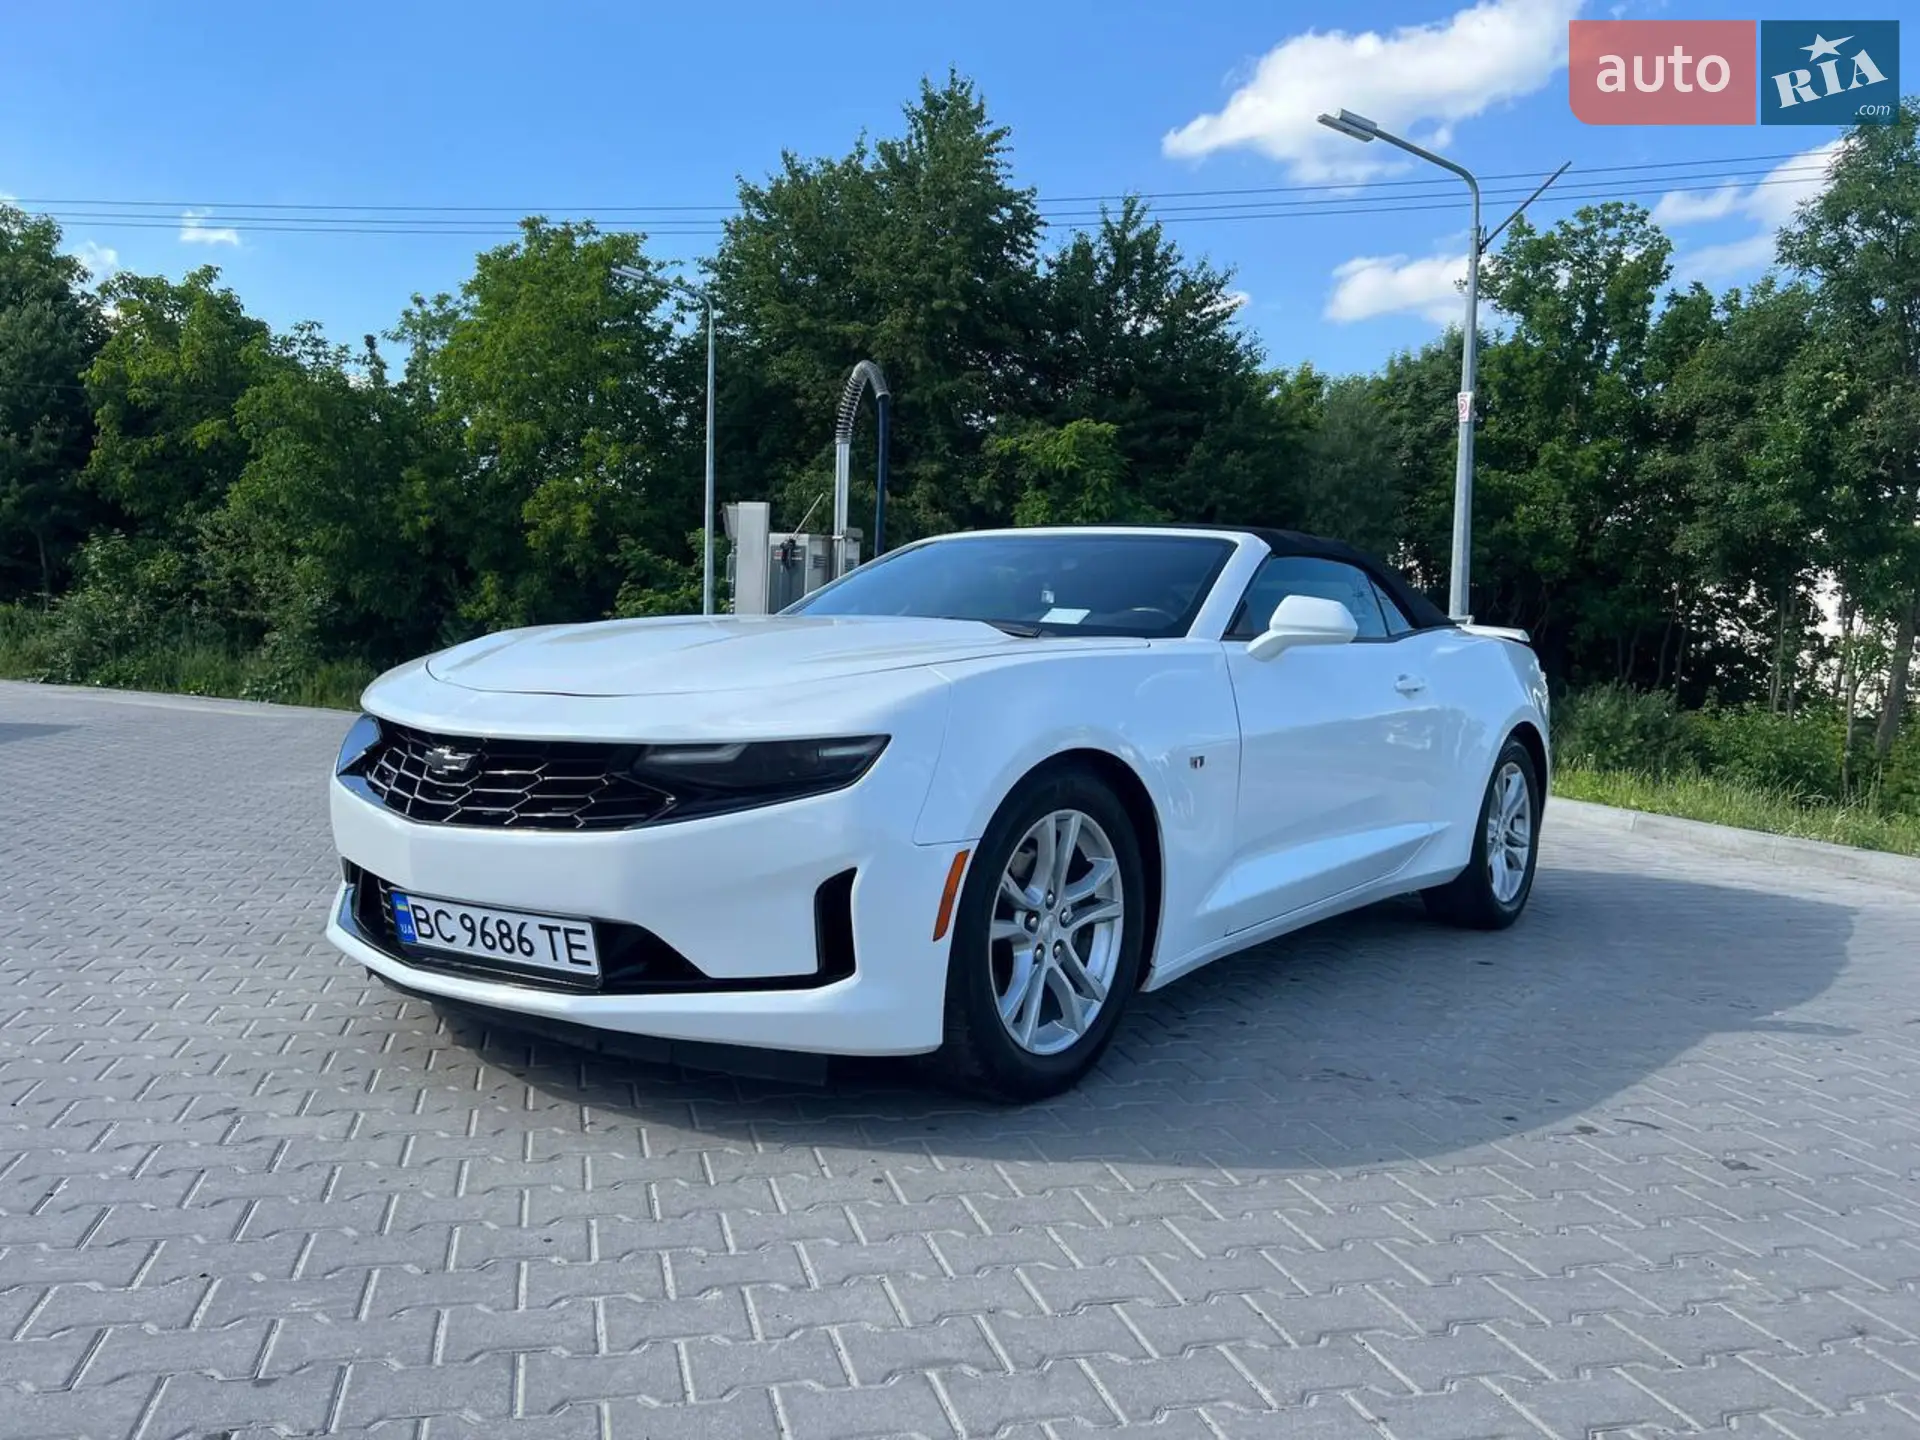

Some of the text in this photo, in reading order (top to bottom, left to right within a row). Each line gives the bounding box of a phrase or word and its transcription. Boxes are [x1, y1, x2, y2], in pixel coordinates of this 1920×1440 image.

[400, 923, 414, 935] UA
[410, 904, 592, 967] BC 9686 TE
